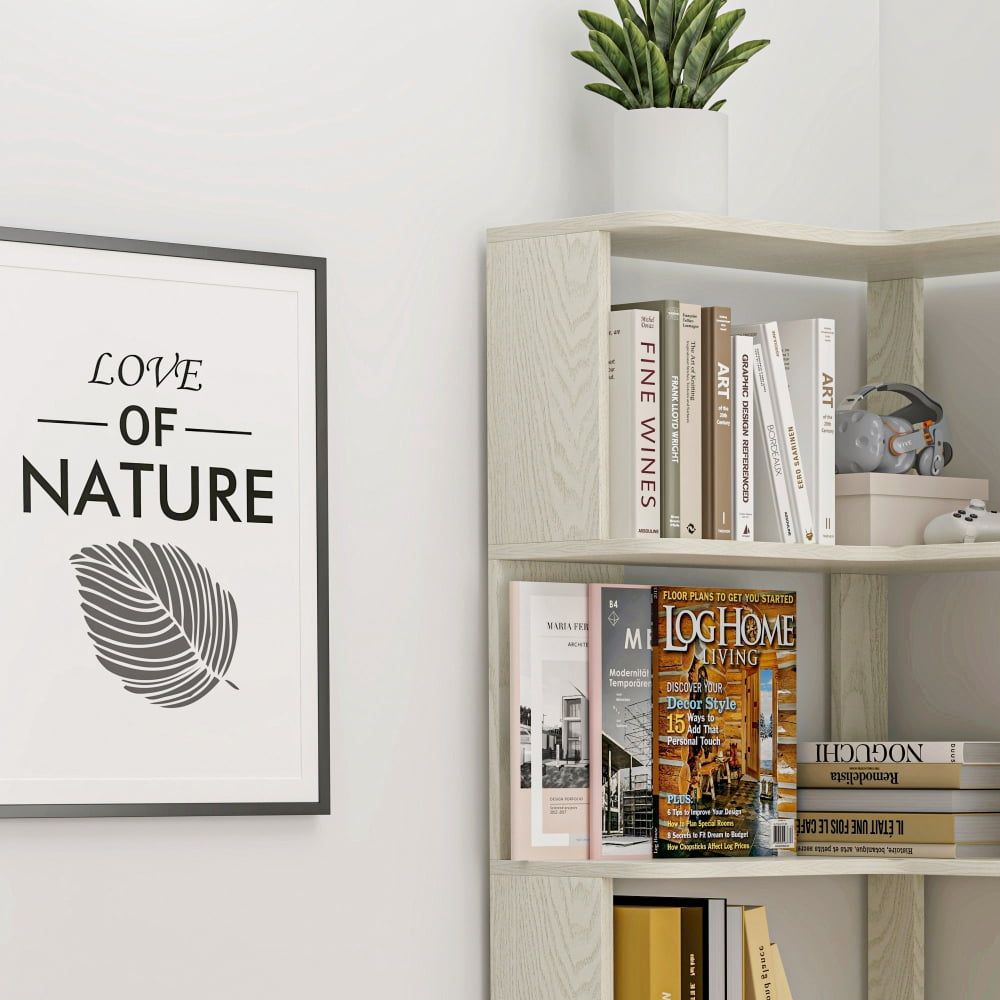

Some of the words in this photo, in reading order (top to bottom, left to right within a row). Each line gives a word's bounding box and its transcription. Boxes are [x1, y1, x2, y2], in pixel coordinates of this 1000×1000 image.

[88, 352, 203, 391] LOVE
[640, 341, 656, 403] FINE
[717, 362, 730, 400] ART
[671, 375, 679, 401] FRANK
[821, 372, 834, 409] ART
[119, 404, 178, 447] OF
[671, 403, 679, 428] LLOYD
[671, 430, 679, 464] WRIGHT
[767, 424, 782, 476] BORDEAUX
[786, 426, 801, 467] SAARINEN
[640, 416, 656, 508] WINES
[22, 454, 274, 524] NATURE
[795, 469, 804, 490] EERO
[609, 599, 618, 609] B4
[663, 590, 688, 601] FLOOR
[690, 591, 714, 602] PLANS
[716, 592, 726, 602] TO
[728, 593, 742, 603] GET
[744, 593, 760, 603] YOU
[761, 594, 794, 604] STARTED
[547, 622, 572, 631] MARIA
[703, 648, 759, 666] LIVING
[666, 681, 702, 693] DISCOVER
[704, 681, 723, 693] YOUR
[666, 696, 702, 710] Decor
[705, 696, 737, 714] Style
[666, 713, 686, 734] 15
[687, 712, 705, 723] Ways
[707, 713, 715, 722] to
[687, 724, 701, 734] Add
[703, 724, 719, 734] That
[667, 736, 698, 746] Personal
[701, 736, 721, 746] Touch
[815, 743, 924, 763] NOGUCHI
[830, 771, 899, 785] Remodelista
[667, 794, 694, 805] PLUS:
[671, 809, 683, 817] Tips
[690, 808, 711, 817] Improve
[712, 808, 724, 816] Your
[724, 808, 742, 817] Design
